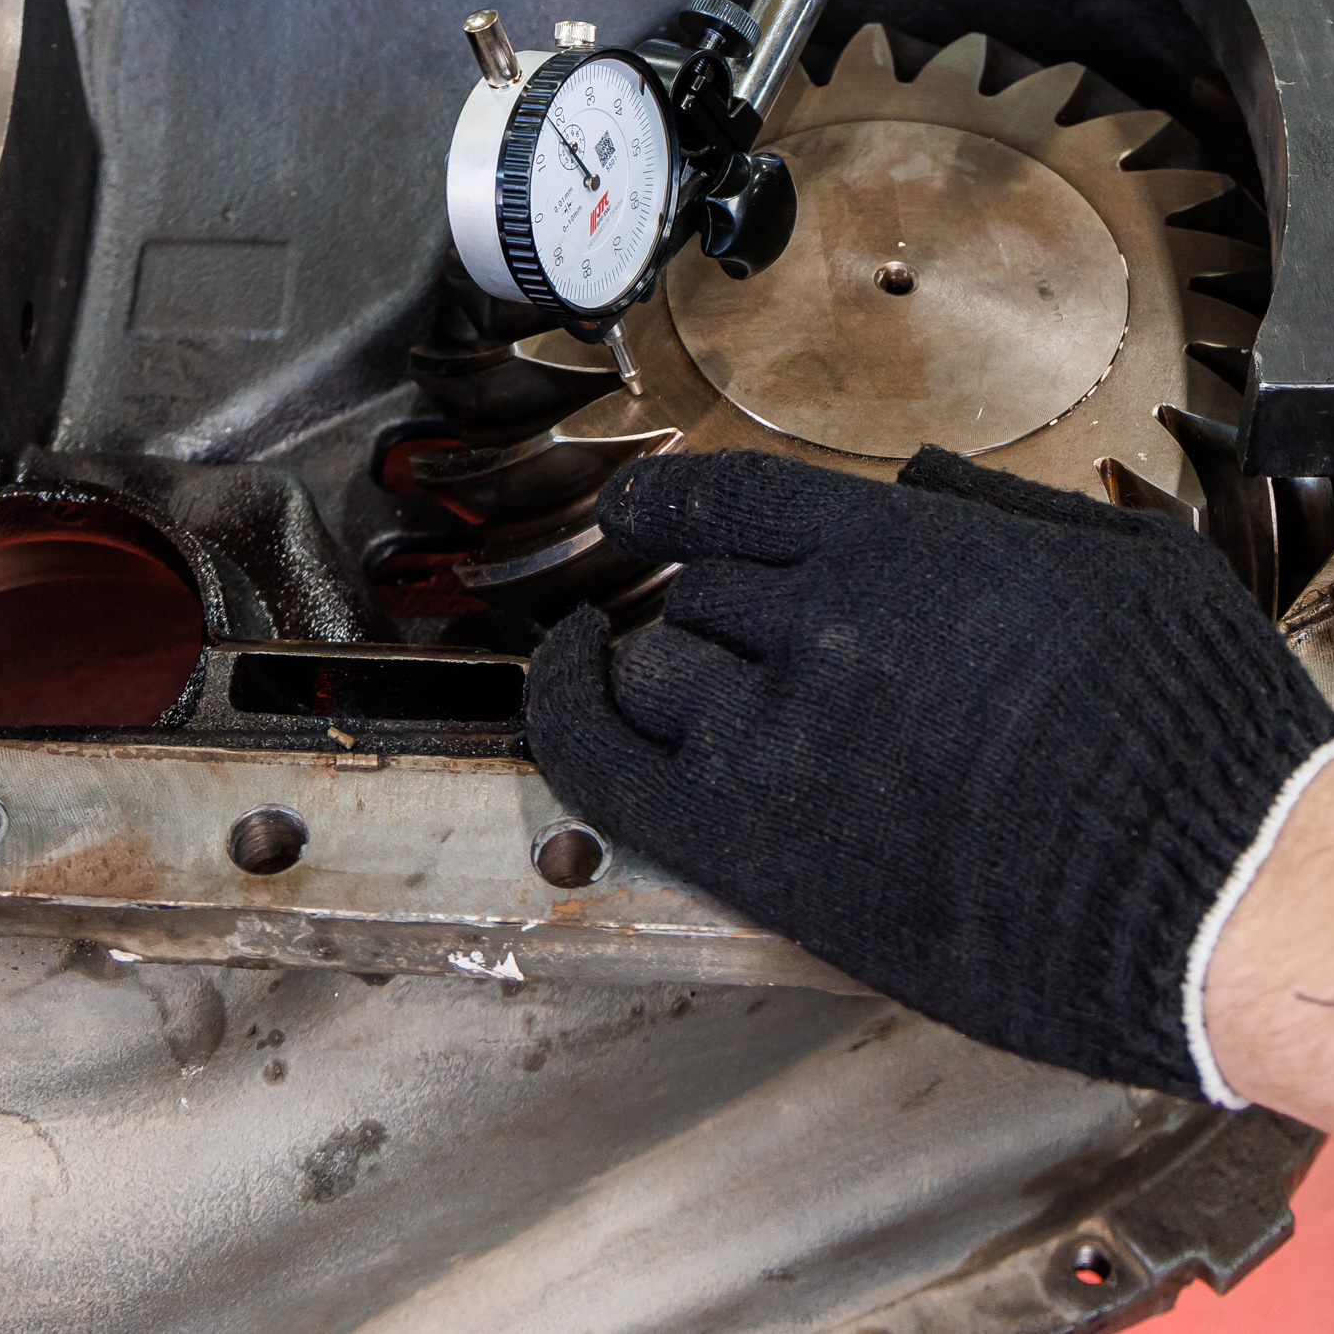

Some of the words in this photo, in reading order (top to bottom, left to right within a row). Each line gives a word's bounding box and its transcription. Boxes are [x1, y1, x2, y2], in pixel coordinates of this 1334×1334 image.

[585, 86, 595, 106] 30
[554, 106, 566, 127] 20
[613, 98, 623, 116] 40
[631, 138, 642, 157] 50
[535, 153, 547, 173] 10
[629, 191, 640, 210] 60
[534, 212, 544, 224] 0
[553, 246, 564, 267] 90
[612, 236, 623, 257] 70
[581, 258, 592, 279] 80
